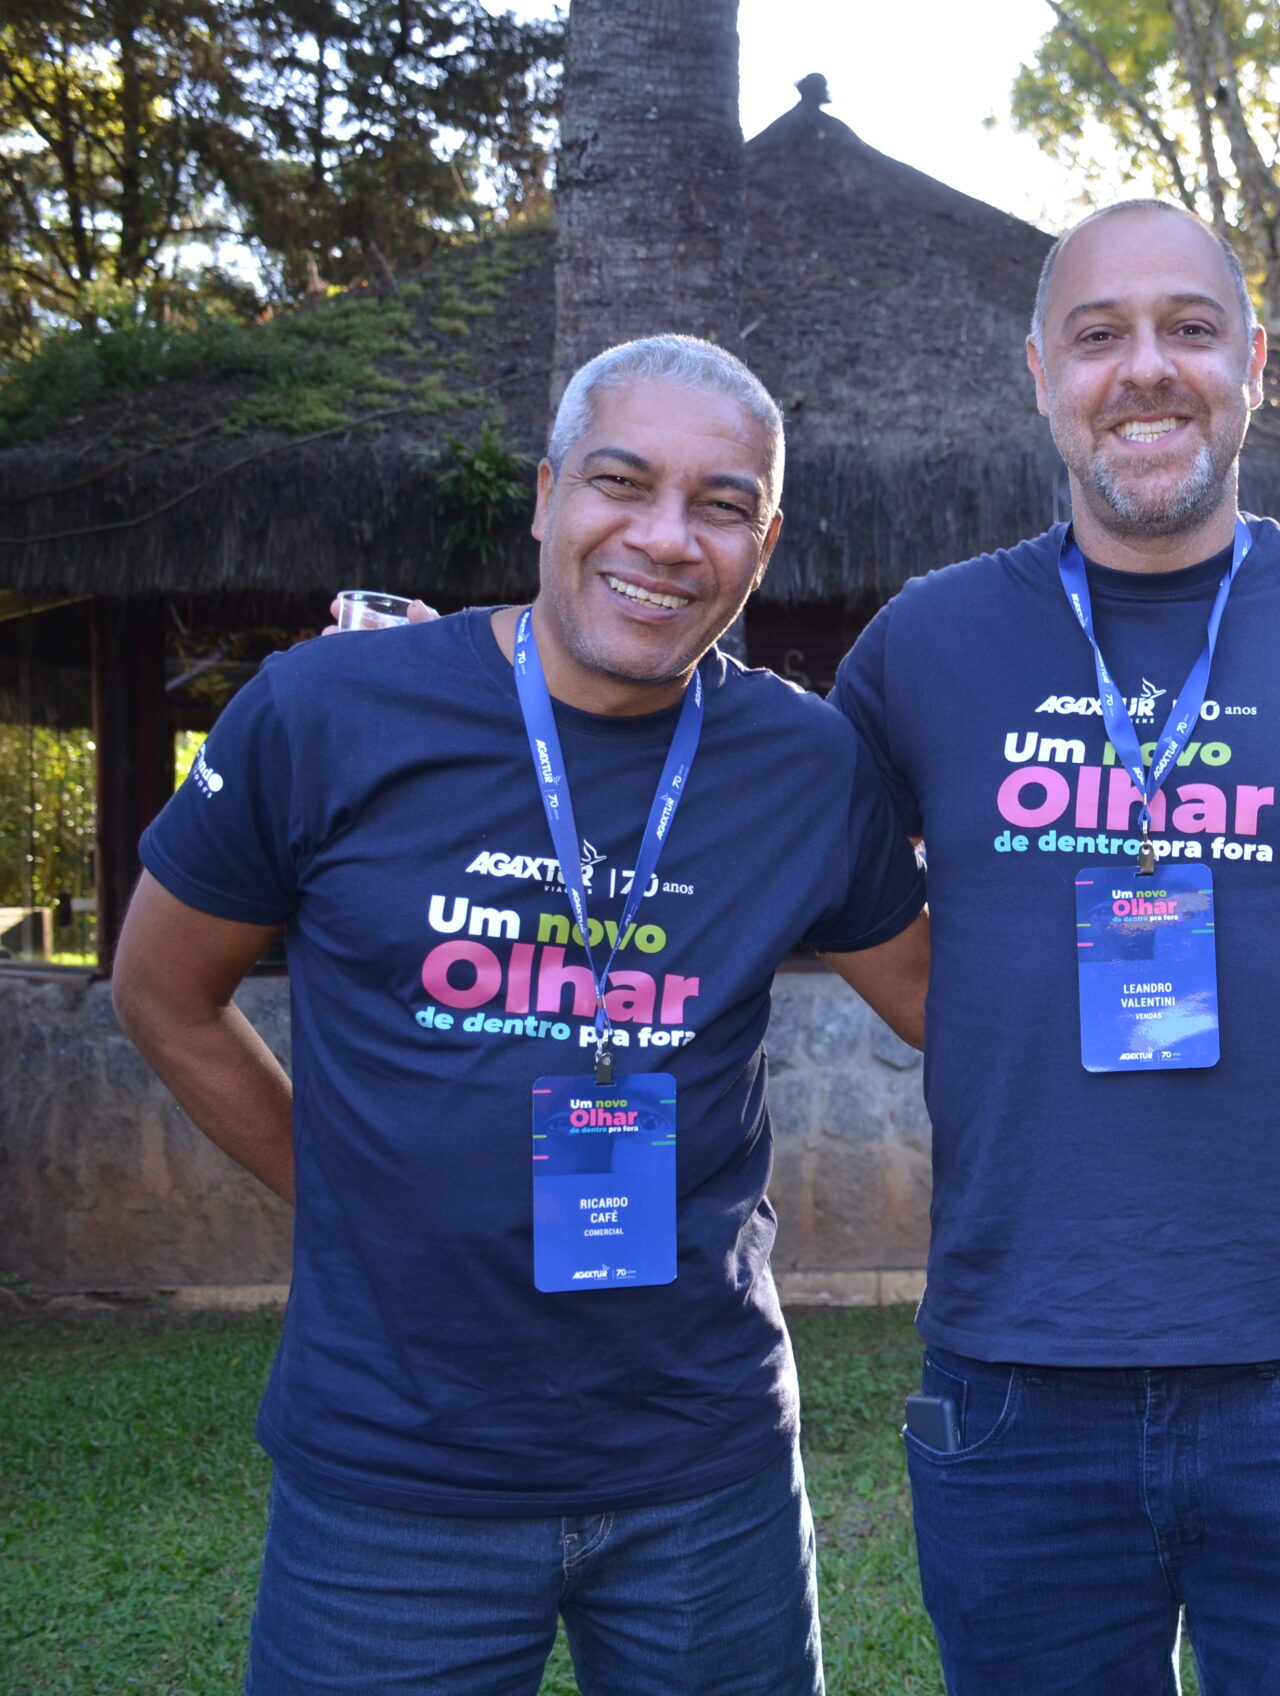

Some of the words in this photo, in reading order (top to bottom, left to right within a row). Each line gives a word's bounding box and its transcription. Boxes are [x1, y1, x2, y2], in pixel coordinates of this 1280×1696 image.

[1224, 706, 1258, 716] anos
[1176, 722, 1187, 734] 70
[1004, 732, 1086, 763] Um
[548, 794, 559, 808] 70
[997, 765, 1275, 835] Olhar
[994, 830, 1029, 852] de
[1038, 830, 1141, 855] dentro
[1154, 837, 1202, 862] pra
[1211, 837, 1274, 862] fora
[465, 851, 593, 886] AGAXTR
[663, 882, 694, 895] anos
[1111, 889, 1133, 899] Um
[1136, 890, 1167, 898] novo
[1112, 898, 1178, 916] Olhar
[428, 895, 520, 939] Um
[537, 913, 667, 954] novo
[1149, 915, 1162, 923] pra
[421, 939, 700, 1025] Olhar
[1123, 982, 1172, 995] LEANDRO
[1121, 996, 1176, 1009] VALENTINI
[1135, 1012, 1163, 1020] VENDAS
[415, 1006, 454, 1030] de
[462, 1012, 571, 1041] dentro
[637, 1026, 696, 1048] fora
[570, 1099, 592, 1109] Um
[595, 1099, 628, 1108] novo
[570, 1107, 638, 1127] Olhar
[608, 1126, 622, 1134] pra
[580, 1196, 628, 1210] RICARDO
[590, 1210, 618, 1223] CAFÉ
[584, 1227, 624, 1237] COMERCIAL
[616, 1268, 627, 1276] 70
